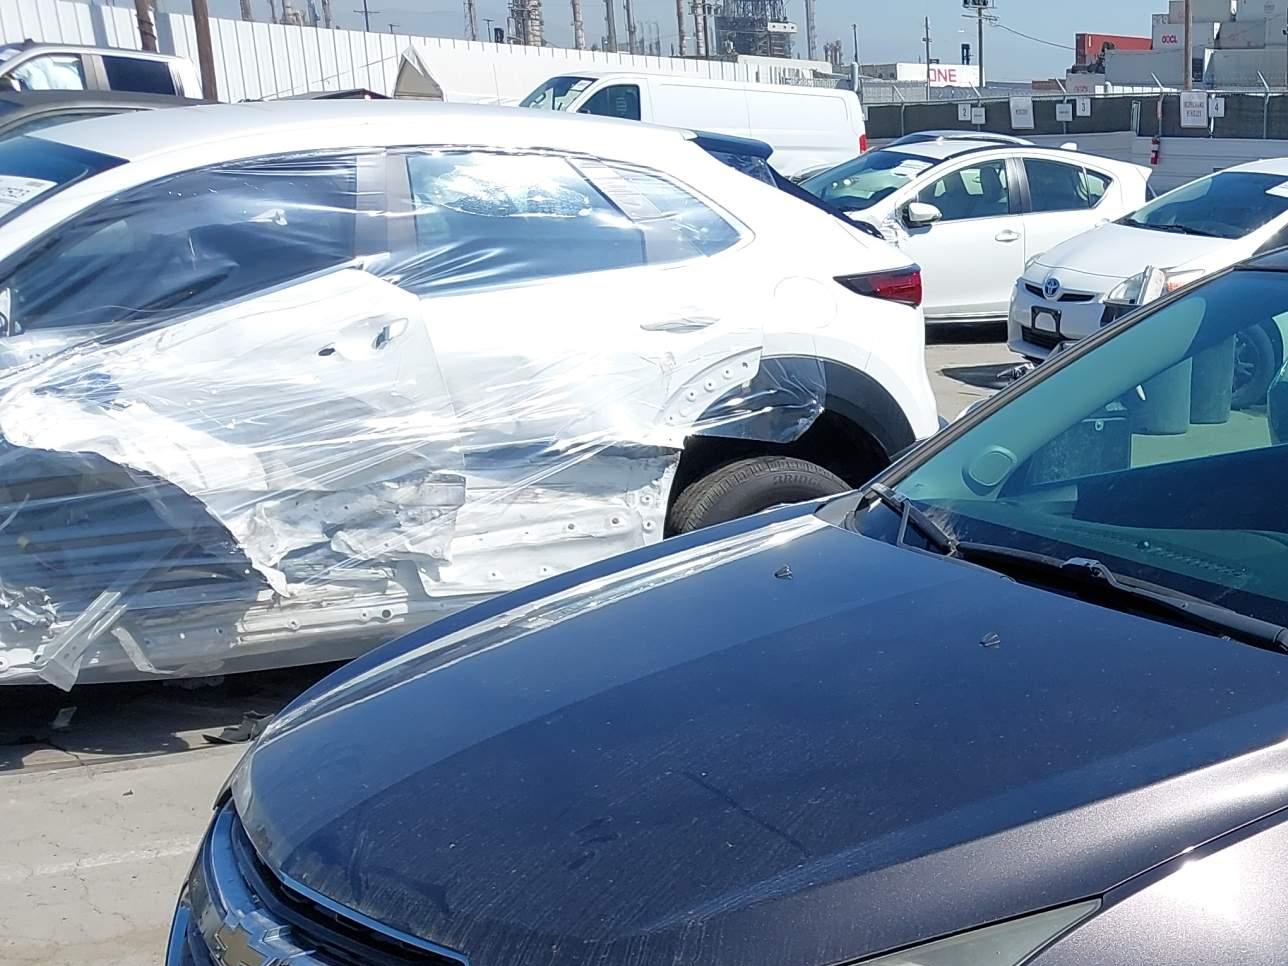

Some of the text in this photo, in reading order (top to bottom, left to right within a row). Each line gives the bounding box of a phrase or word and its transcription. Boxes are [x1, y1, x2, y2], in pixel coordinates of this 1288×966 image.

[929, 68, 957, 83] ONE
[1080, 102, 1087, 112] 3
[1213, 103, 1220, 112] 4
[961, 108, 968, 117] 2
